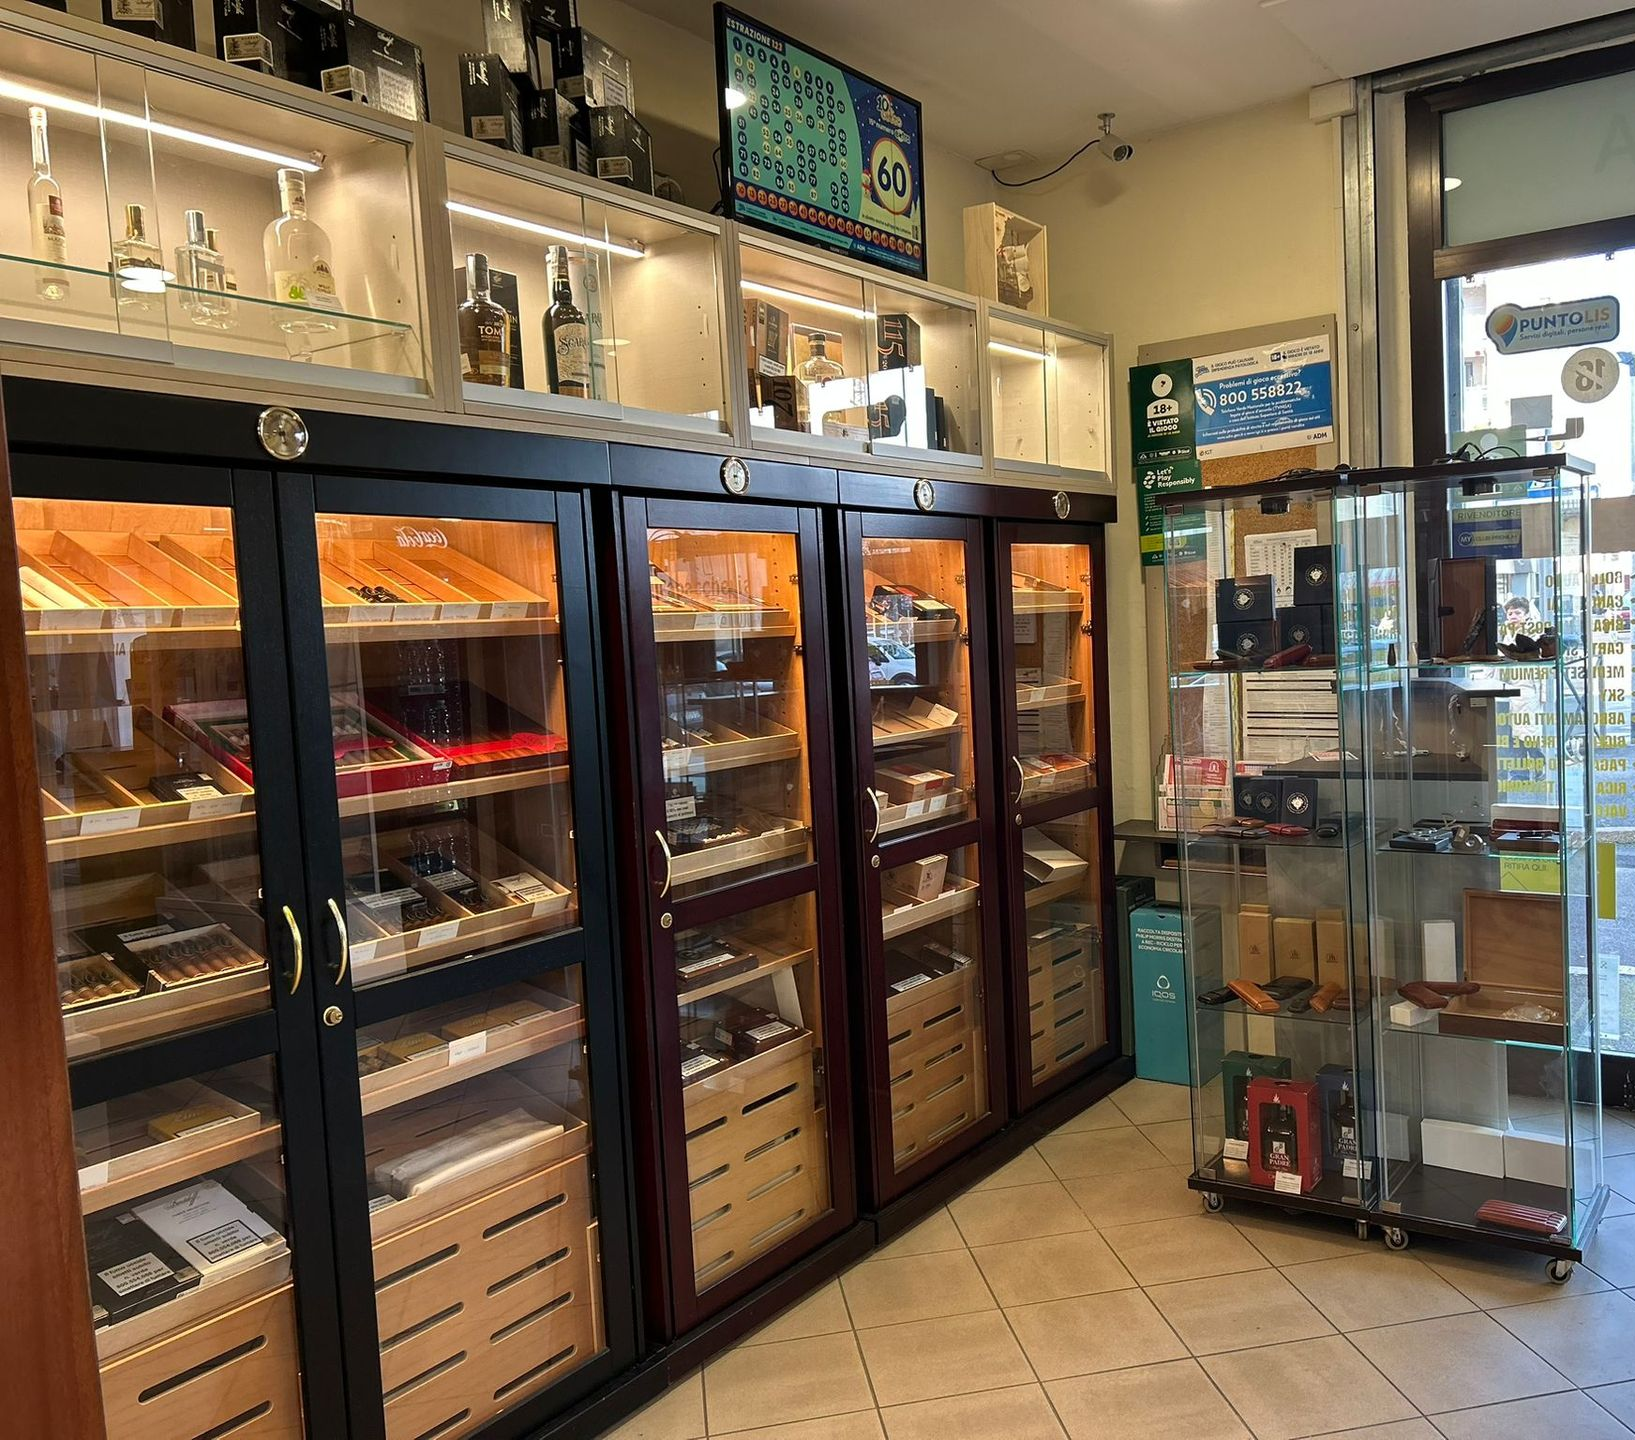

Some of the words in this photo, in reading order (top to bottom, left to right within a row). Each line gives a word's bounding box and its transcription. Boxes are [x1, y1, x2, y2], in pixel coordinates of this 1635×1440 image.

[727, 18, 770, 46] ESTRAZIONE
[878, 156, 906, 198] 60
[1542, 330, 1566, 338] digitali,
[1567, 326, 1593, 335] persone
[878, 318, 904, 357] 115
[1219, 380, 1245, 389] Problemi
[1253, 376, 1269, 384] gioco
[773, 380, 793, 417] 107
[1220, 391, 1247, 406] 800
[1251, 381, 1302, 400] 558822
[1154, 404, 1172, 414] 18+
[1153, 417, 1179, 426] VIETATO
[1156, 424, 1177, 433] GIOCO
[1157, 466, 1174, 475] Let's
[1158, 477, 1195, 488] Responsibly
[1458, 509, 1520, 520] RIVENDITORE
[1461, 535, 1472, 543] MY
[1532, 863, 1547, 871] QUI
[1152, 990, 1175, 999] IQOS
[1270, 1153, 1289, 1161] GRAN
[1270, 1159, 1290, 1167] PADRE
